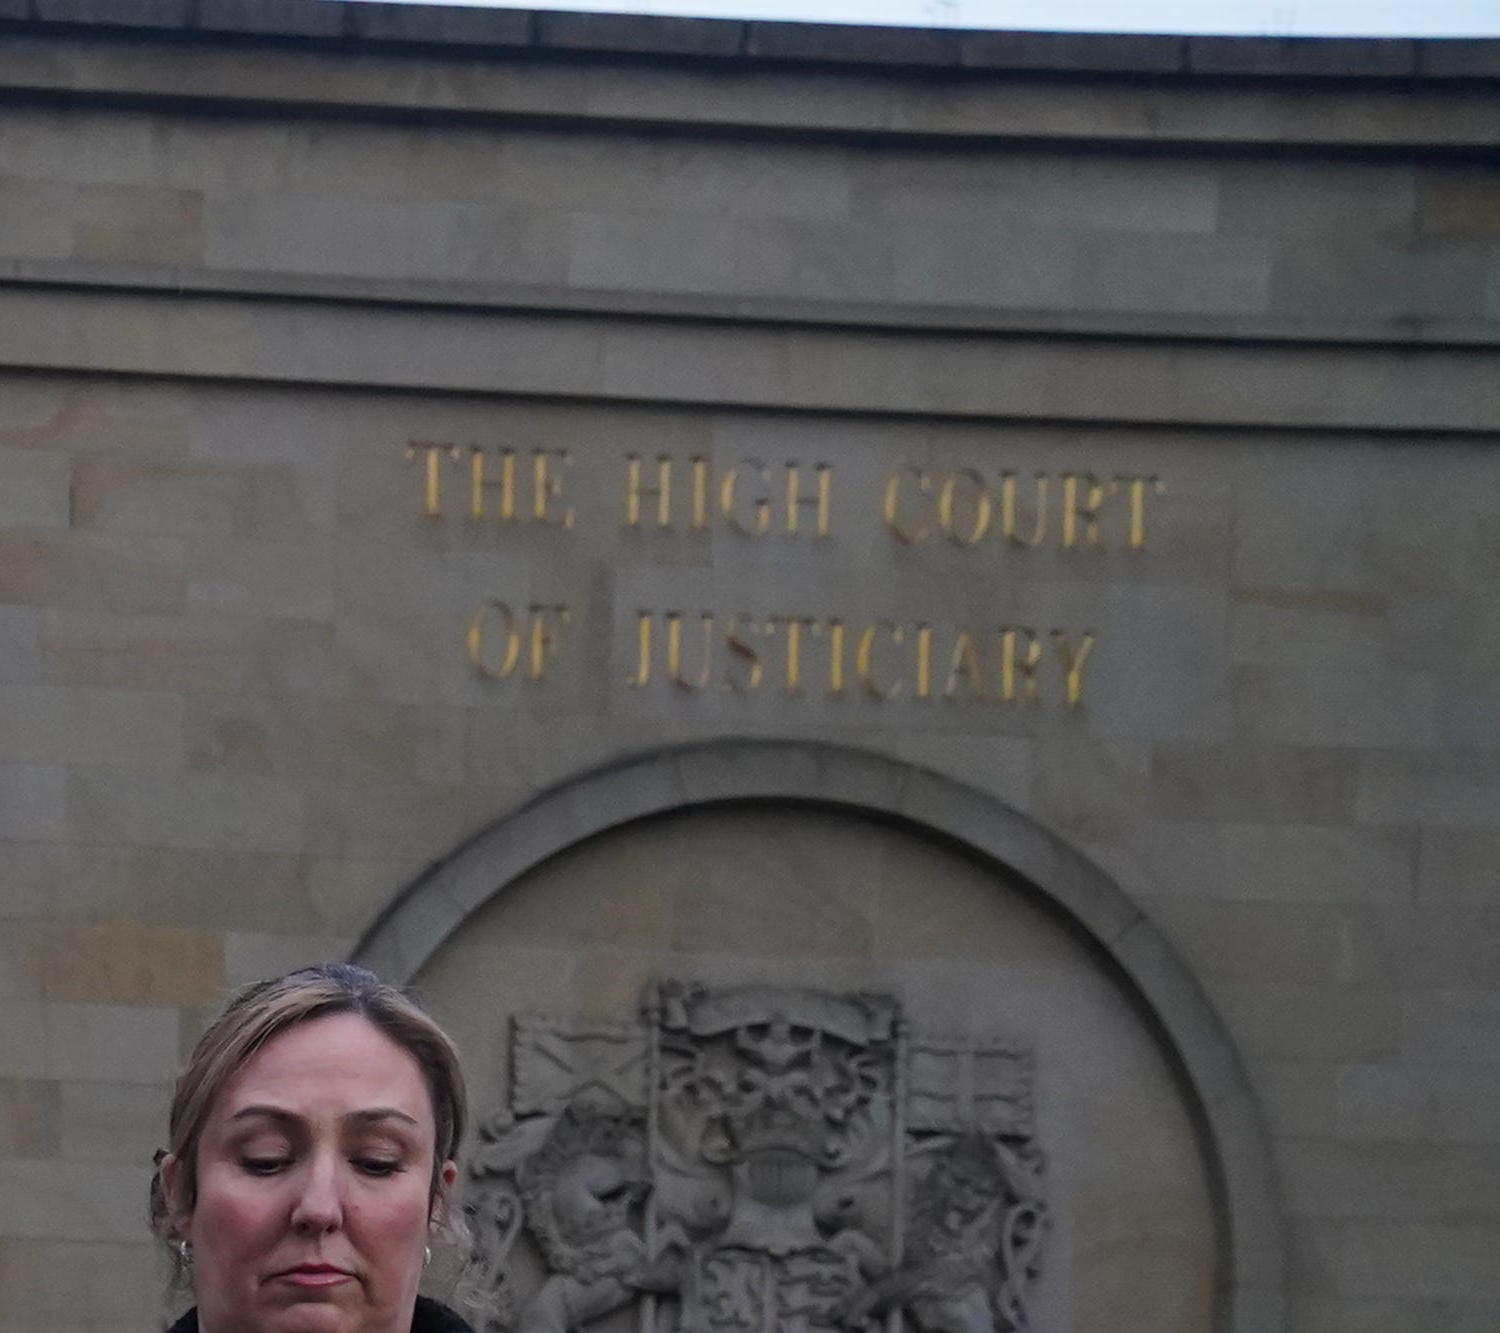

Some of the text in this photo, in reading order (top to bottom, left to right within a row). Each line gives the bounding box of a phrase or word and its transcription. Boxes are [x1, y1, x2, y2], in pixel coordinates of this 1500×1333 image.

[406, 440, 1167, 554] THE HIGH COURT
[467, 598, 1097, 708] OF JUSTICIARY
